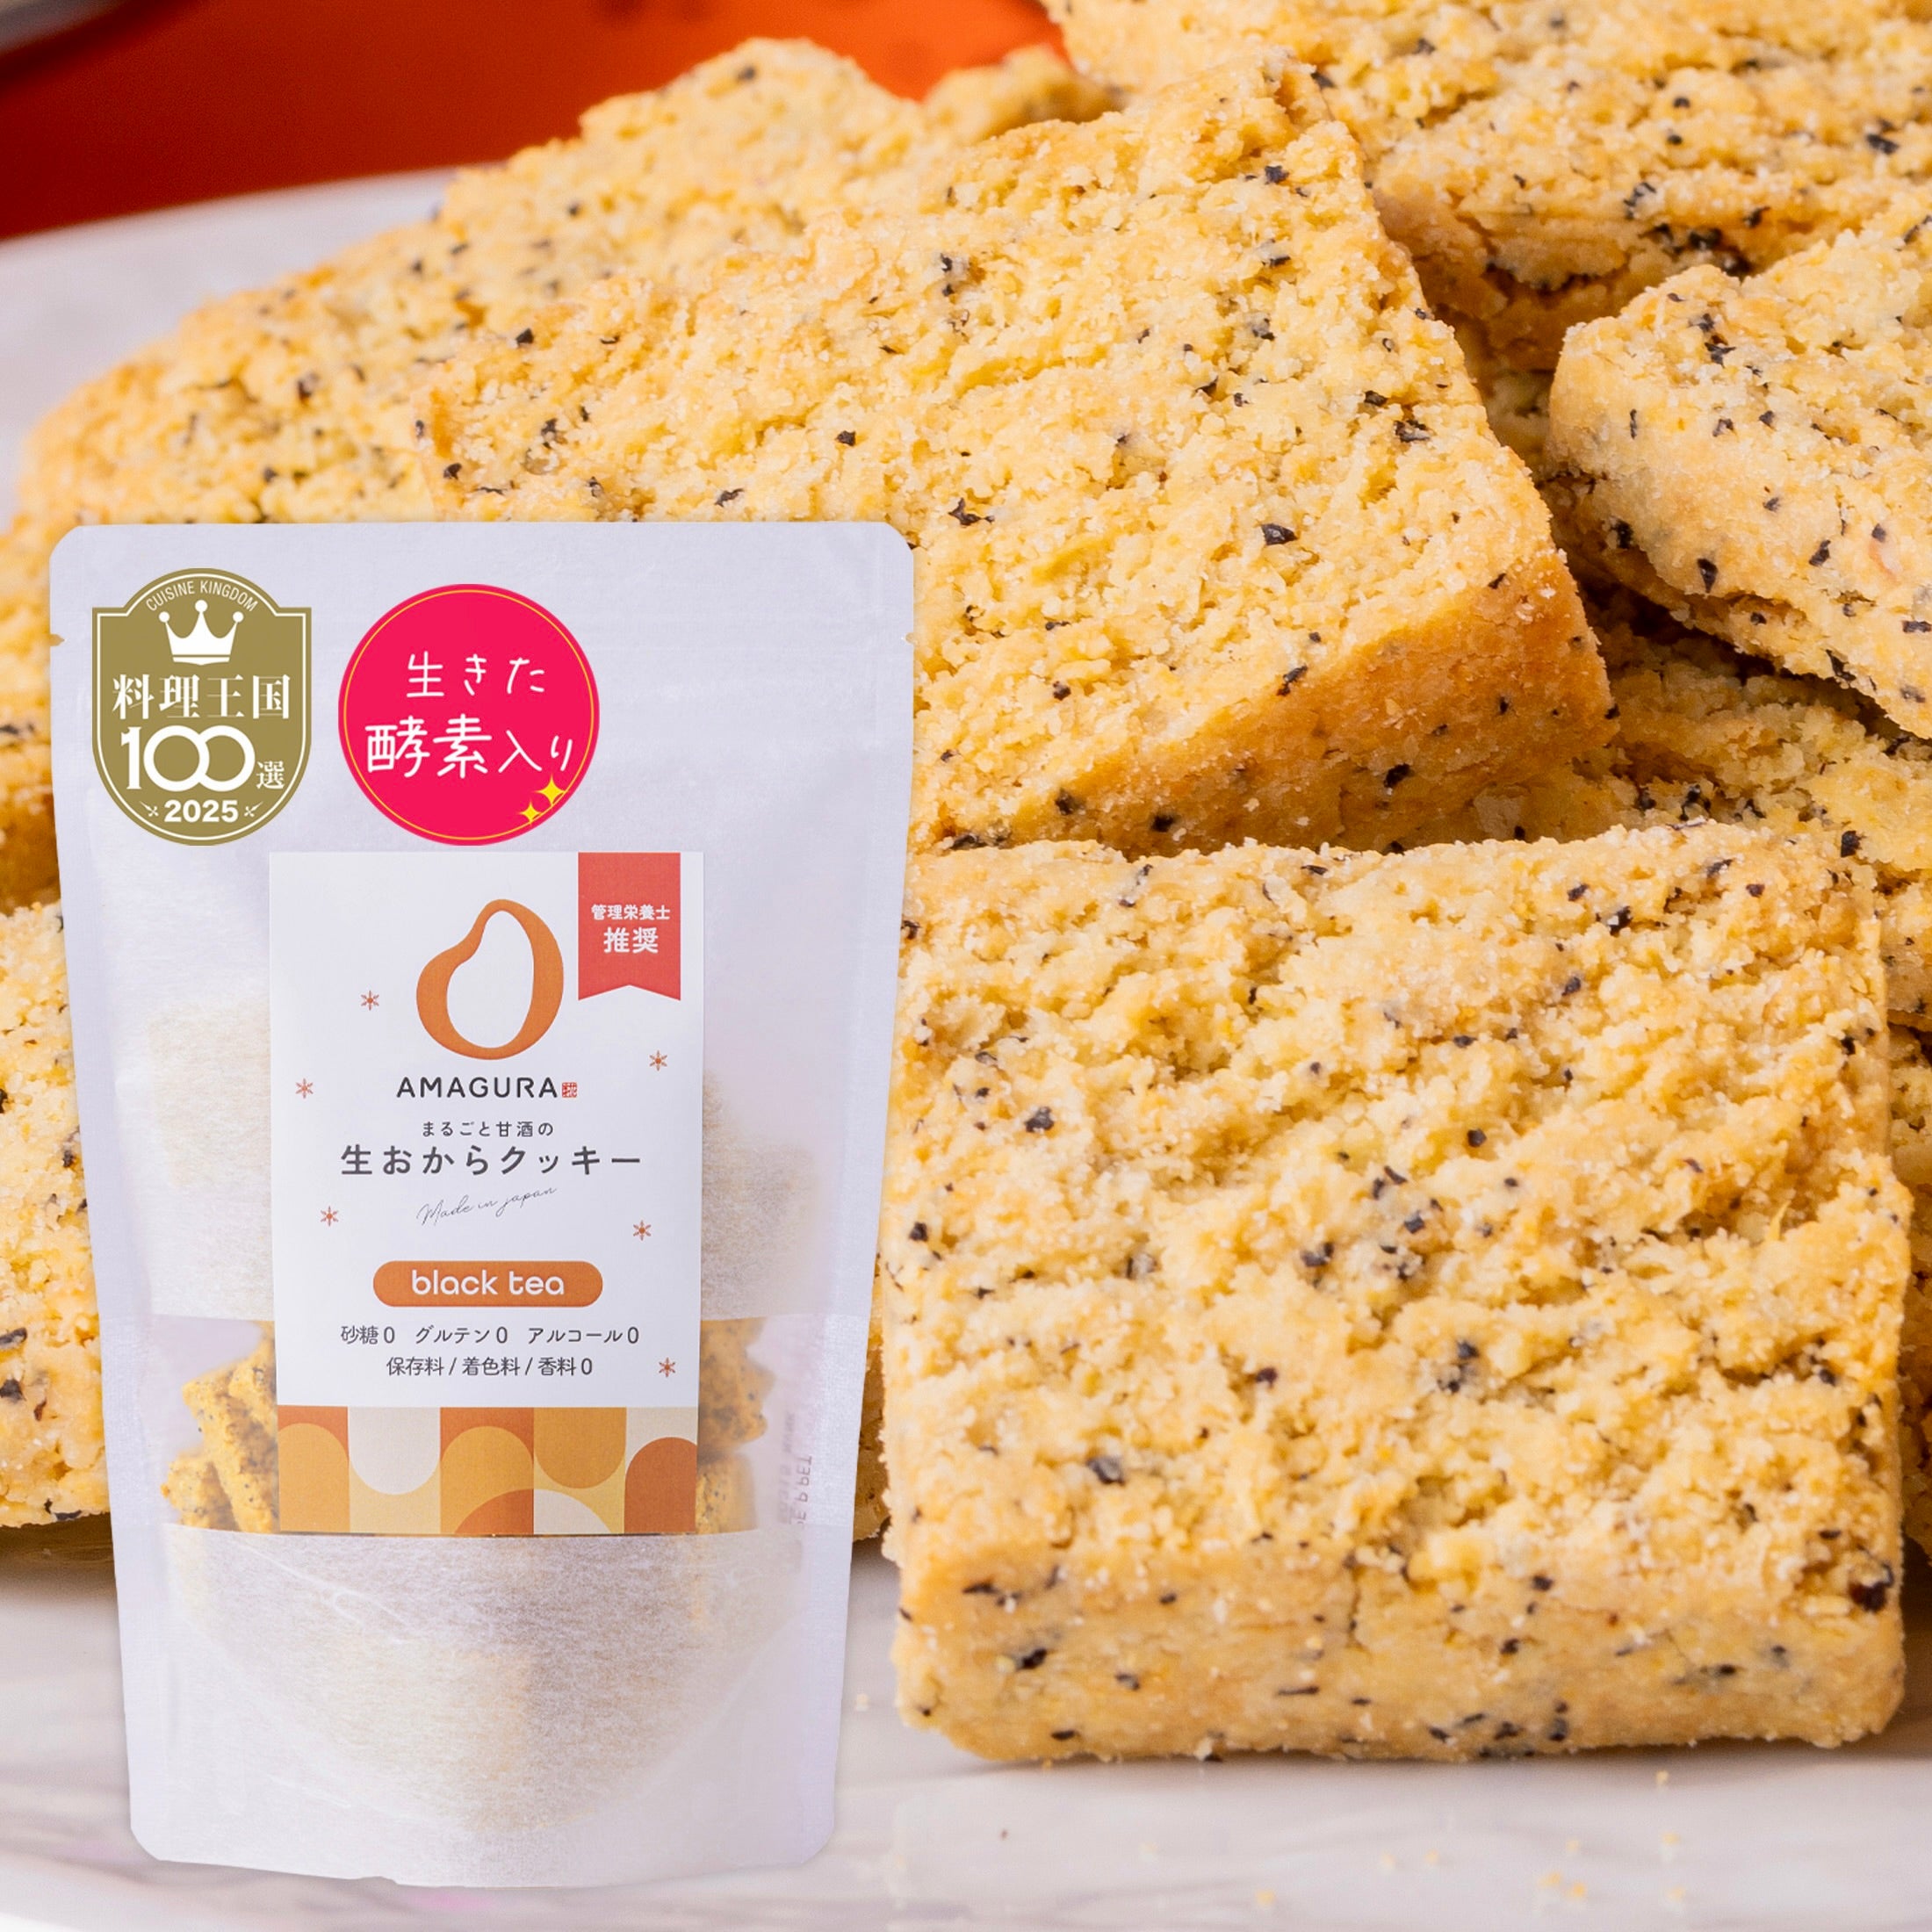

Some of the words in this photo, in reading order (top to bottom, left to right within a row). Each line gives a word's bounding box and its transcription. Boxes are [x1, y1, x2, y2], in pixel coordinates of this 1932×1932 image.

[591, 904, 671, 921] 管理栄養士
[603, 926, 659, 954] 推奨
[396, 1077, 559, 1099] AMAGURA
[422, 1121, 554, 1137] まるごと甘酒の
[341, 1143, 641, 1176] 生おからクッキー
[416, 1194, 473, 1226] Made
[478, 1200, 498, 1209] in
[411, 1269, 499, 1296] black
[508, 1270, 565, 1296] tea
